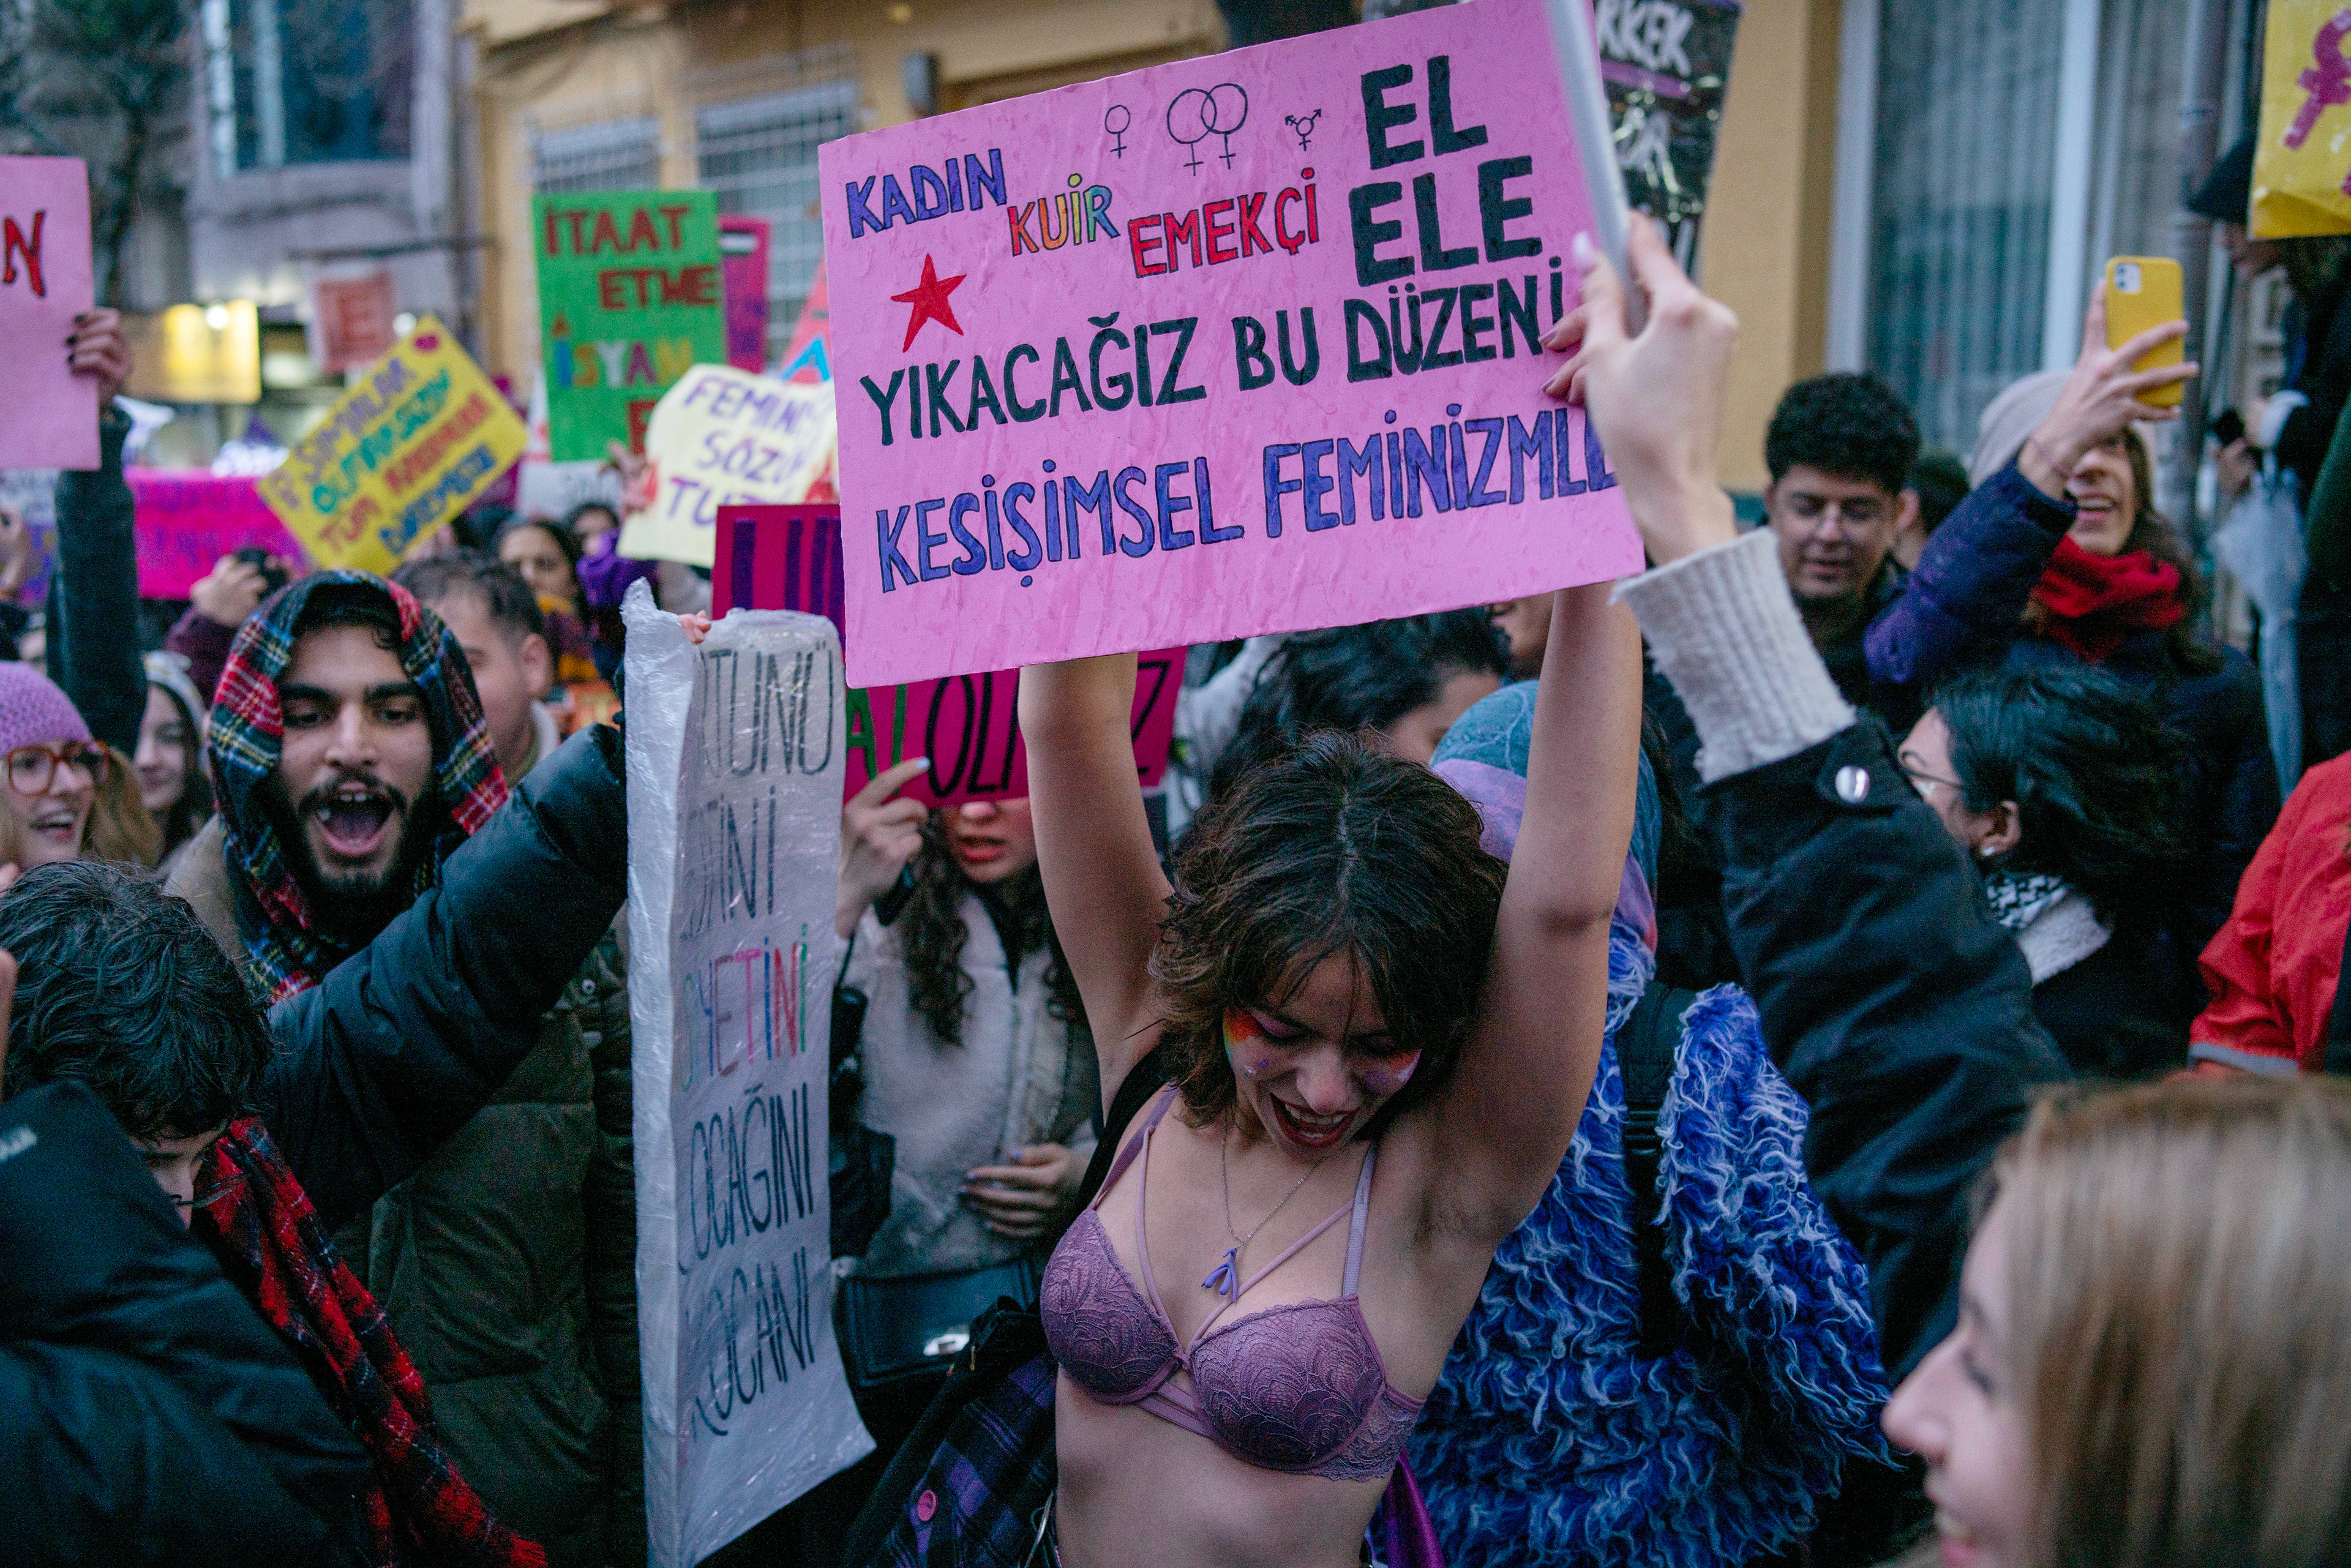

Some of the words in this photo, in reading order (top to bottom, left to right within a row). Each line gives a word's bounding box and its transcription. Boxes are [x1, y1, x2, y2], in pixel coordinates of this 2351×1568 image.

[1360, 54, 1488, 170] EL
[846, 148, 1008, 239] KADIN
[1006, 173, 1121, 256] KUİR
[1127, 167, 1320, 279] EMEKÇİ
[1348, 155, 1543, 287] ELE
[859, 311, 1207, 446] YIKACAĞIZ
[1232, 306, 1320, 392] BU
[1343, 255, 1566, 383] DÜZENİ
[876, 456, 1245, 593] KESİŞİMSEL
[677, 1082, 815, 1275] OCAĞINI
